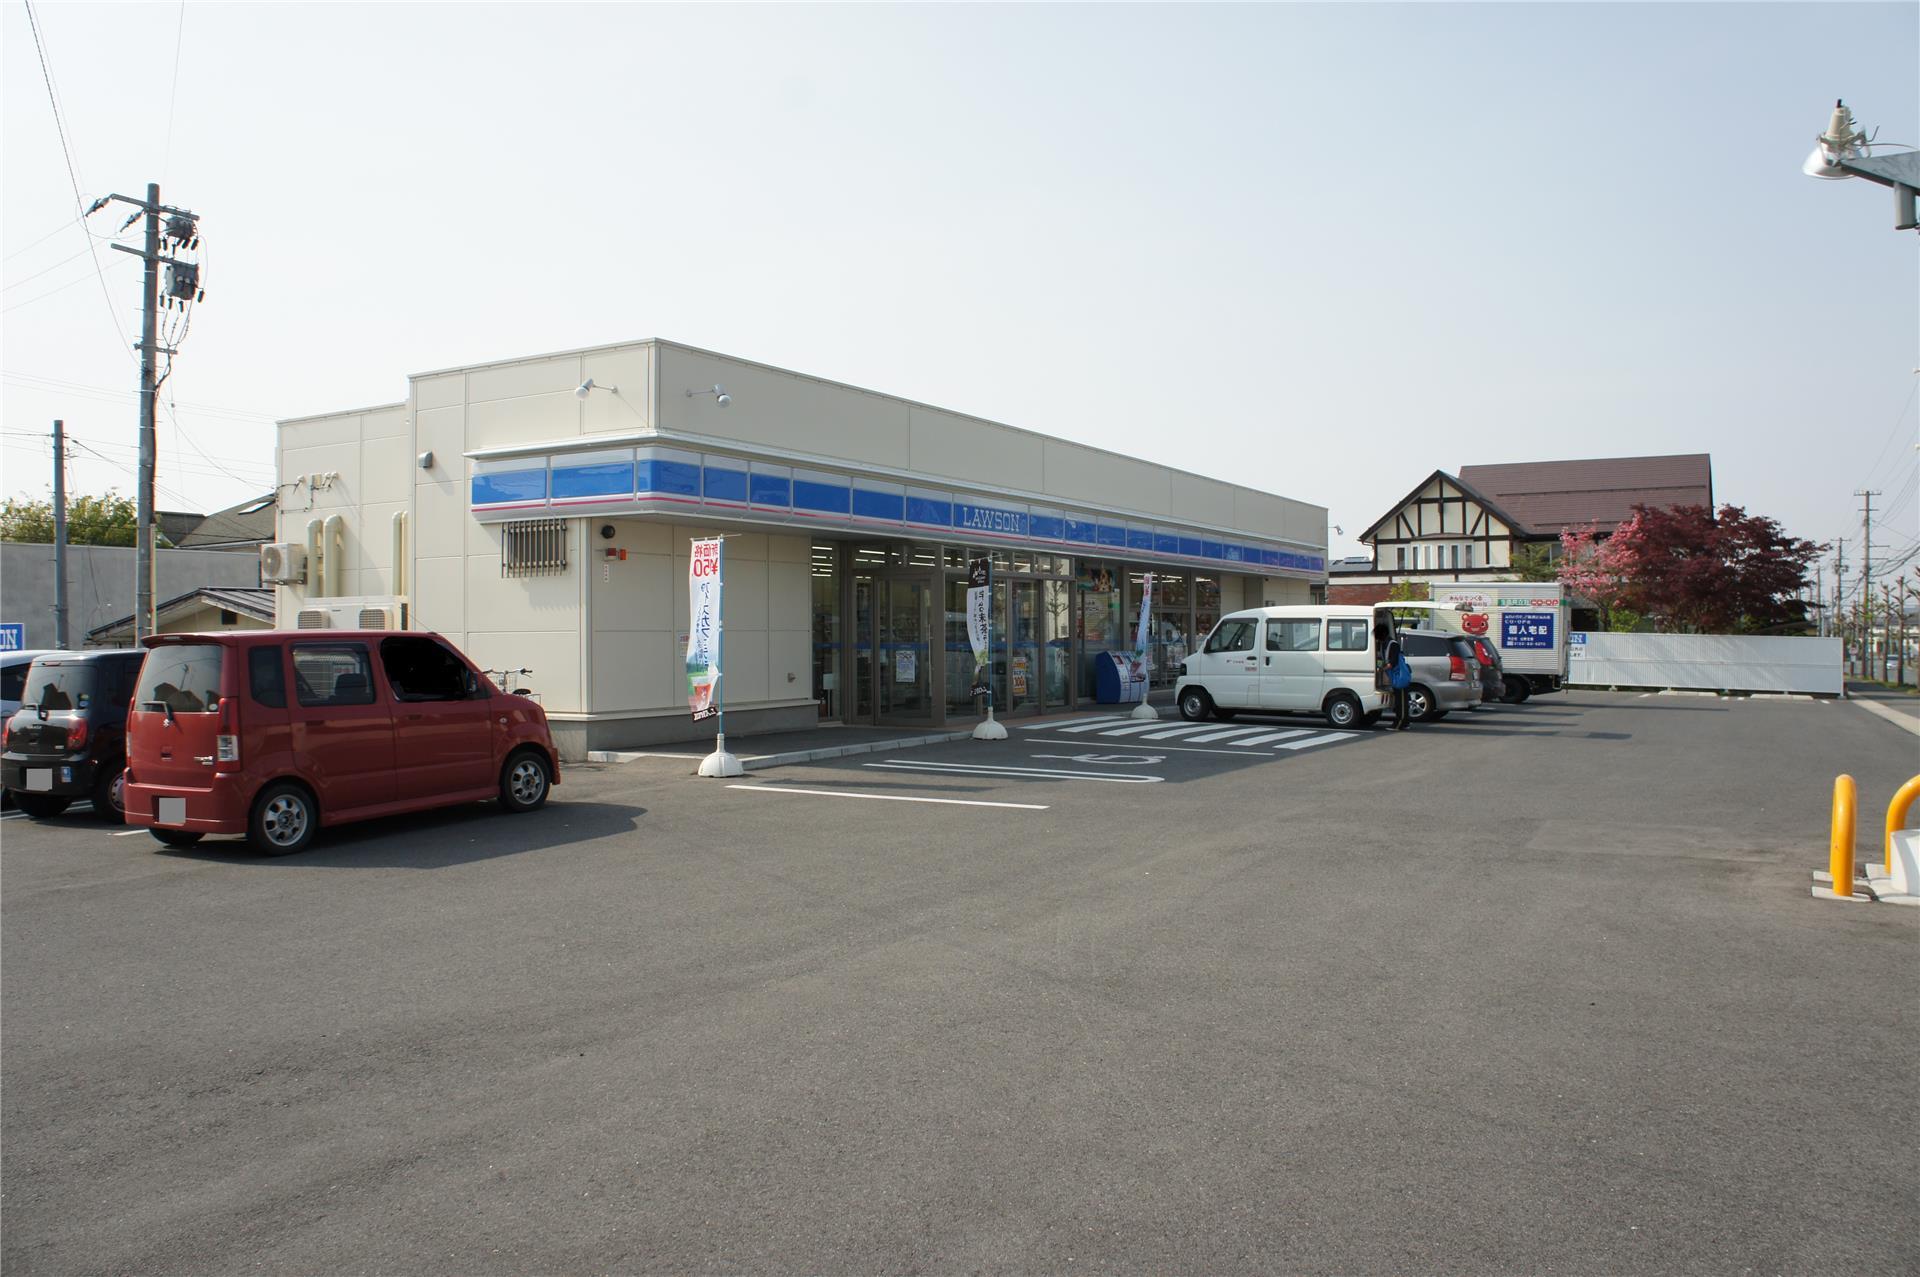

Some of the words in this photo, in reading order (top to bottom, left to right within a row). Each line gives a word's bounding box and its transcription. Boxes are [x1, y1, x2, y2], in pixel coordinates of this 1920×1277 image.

[963, 507, 1020, 532] LAWSON
[1509, 625, 1547, 635] 個人宅配
